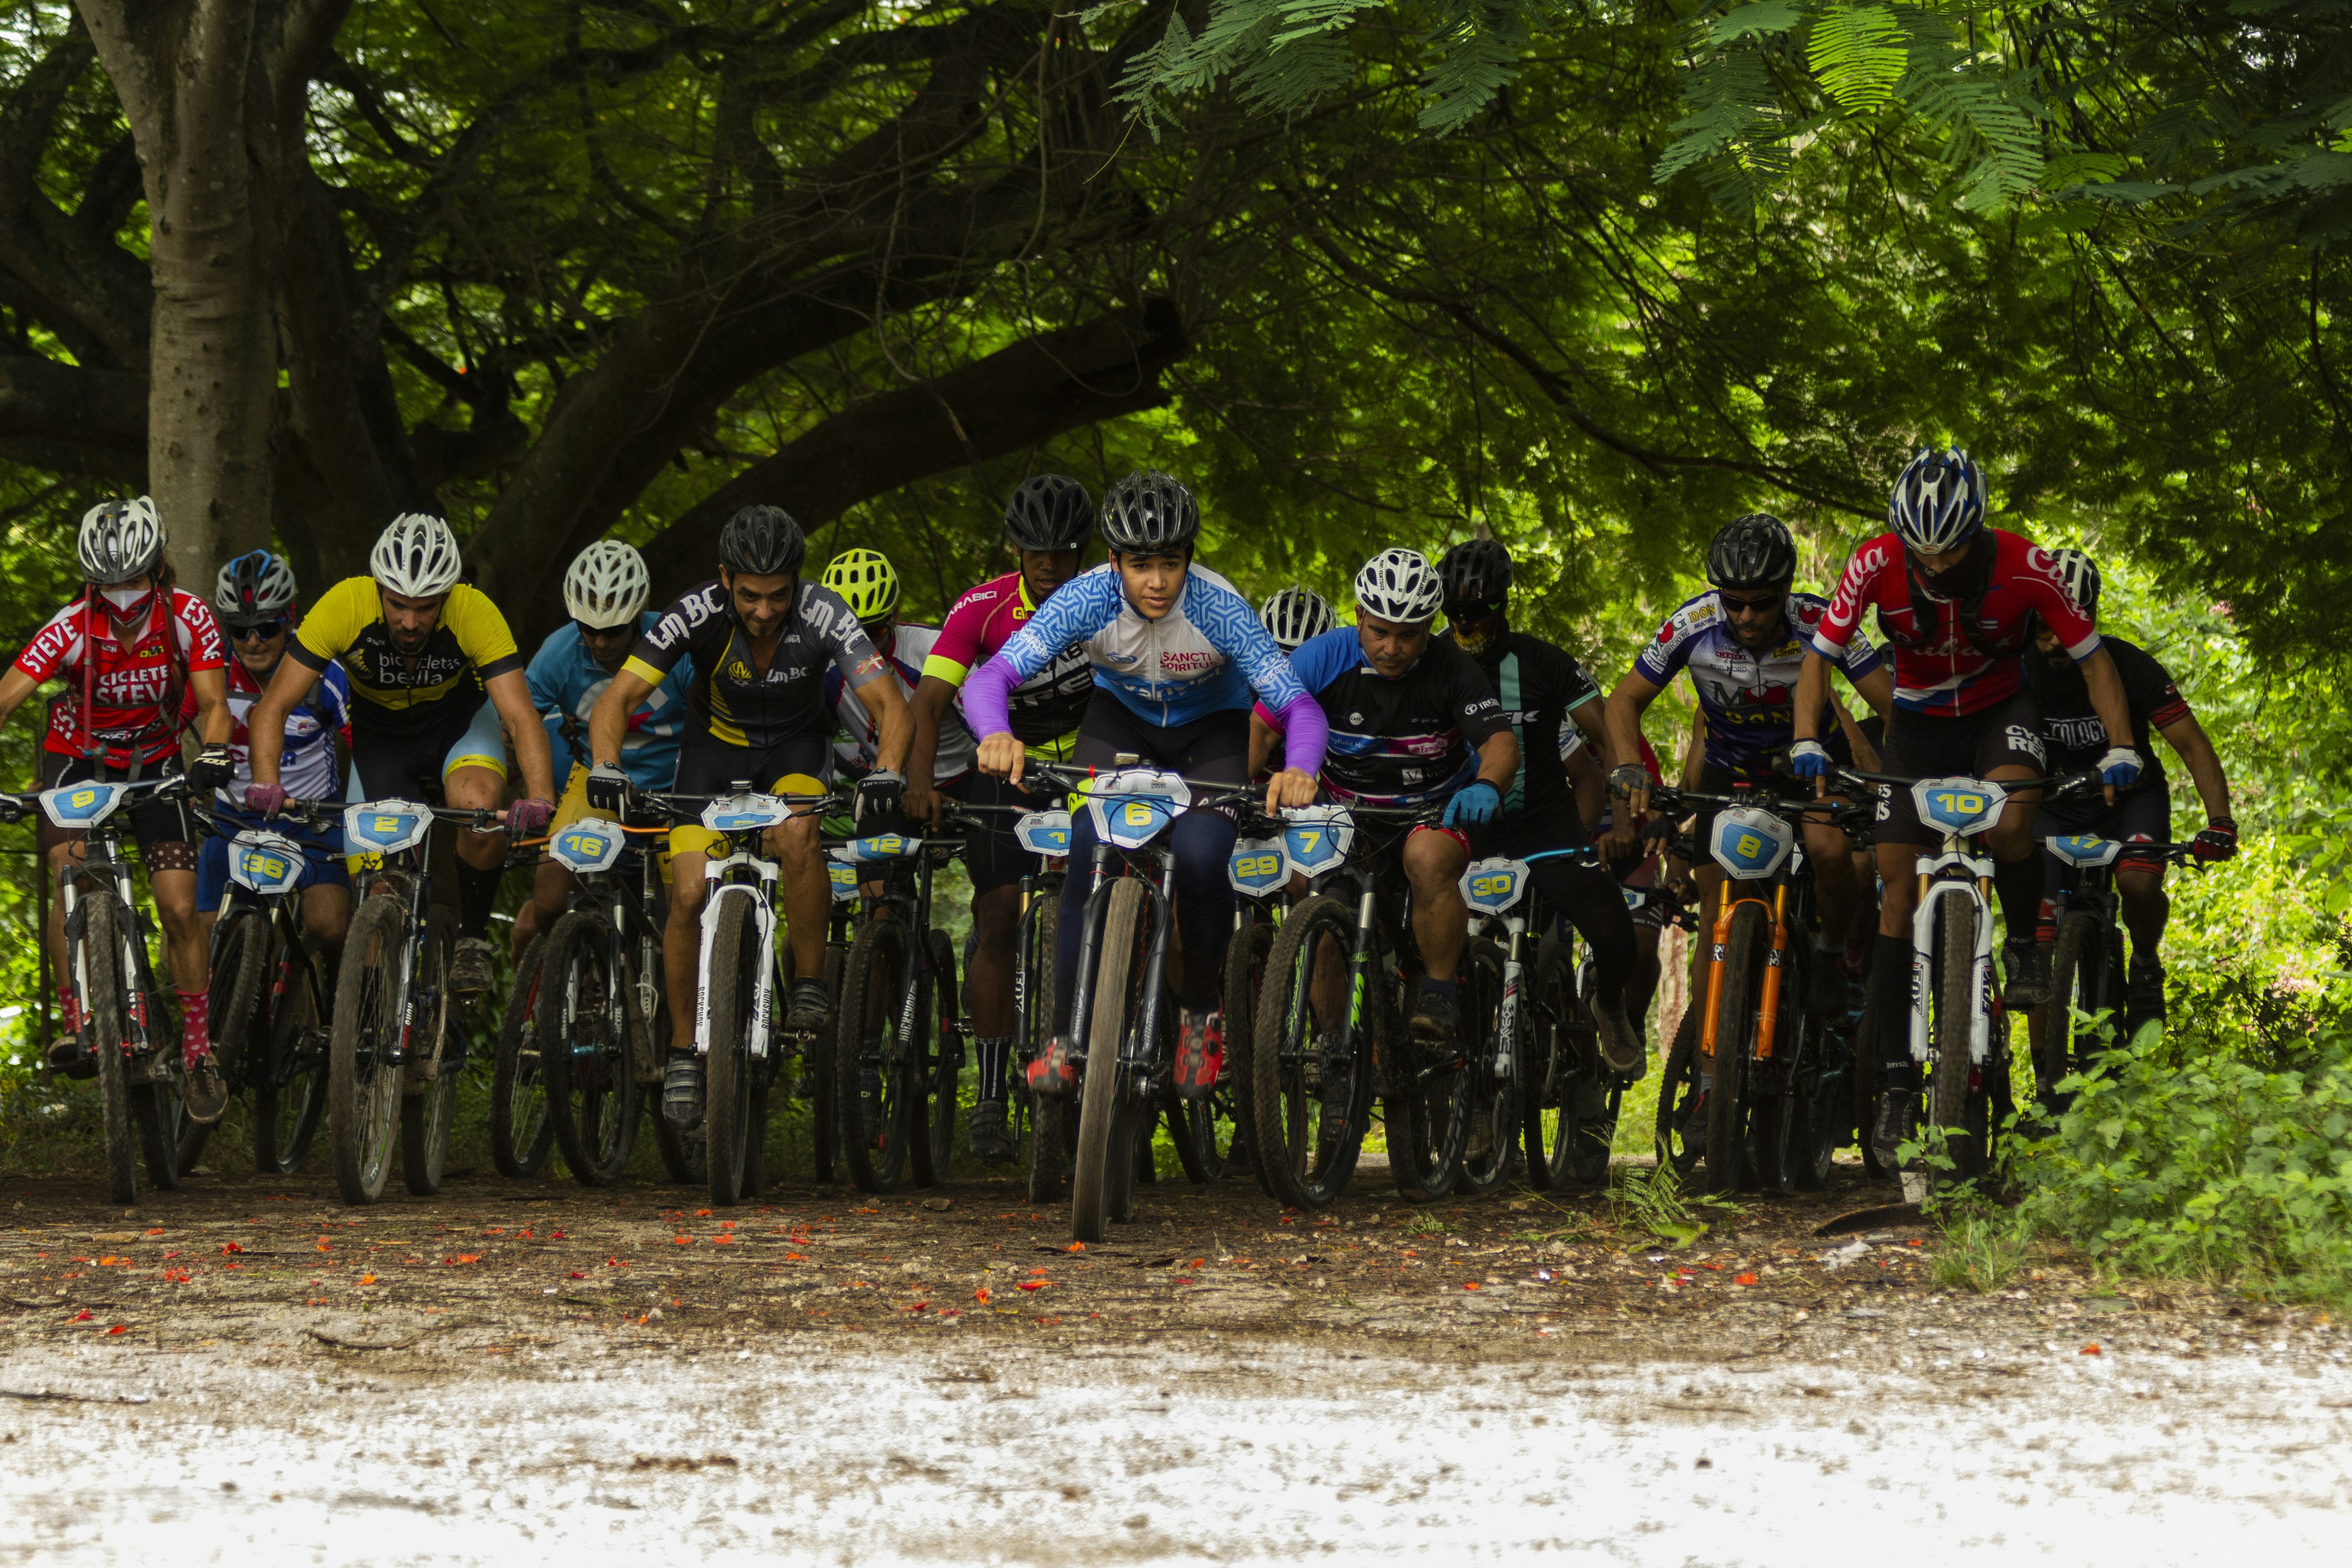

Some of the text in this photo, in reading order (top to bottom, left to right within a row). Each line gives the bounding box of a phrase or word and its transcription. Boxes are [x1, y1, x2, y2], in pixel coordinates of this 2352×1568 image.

[1416, 584, 1425, 597] MONT
[1828, 545, 1890, 627] Cuba
[1163, 652, 1211, 662] SANCTI
[1125, 802, 1152, 826] 6
[1936, 794, 1984, 814] 10
[374, 816, 399, 833] 2
[565, 835, 603, 857] 16
[864, 838, 902, 854] 12
[1048, 832, 1065, 844] 1
[1299, 832, 1321, 853] 7
[1736, 834, 1762, 859] 8
[2066, 836, 2103, 849] 17
[242, 854, 284, 879] 36
[829, 868, 858, 885] 26
[1236, 856, 1279, 878] 29
[1472, 875, 1512, 897] 30
[1712, 944, 1725, 961] 32
[1769, 949, 1782, 967] 32
[1980, 967, 1992, 1016] FOX
[761, 988, 772, 1030] ROCKSHOX
